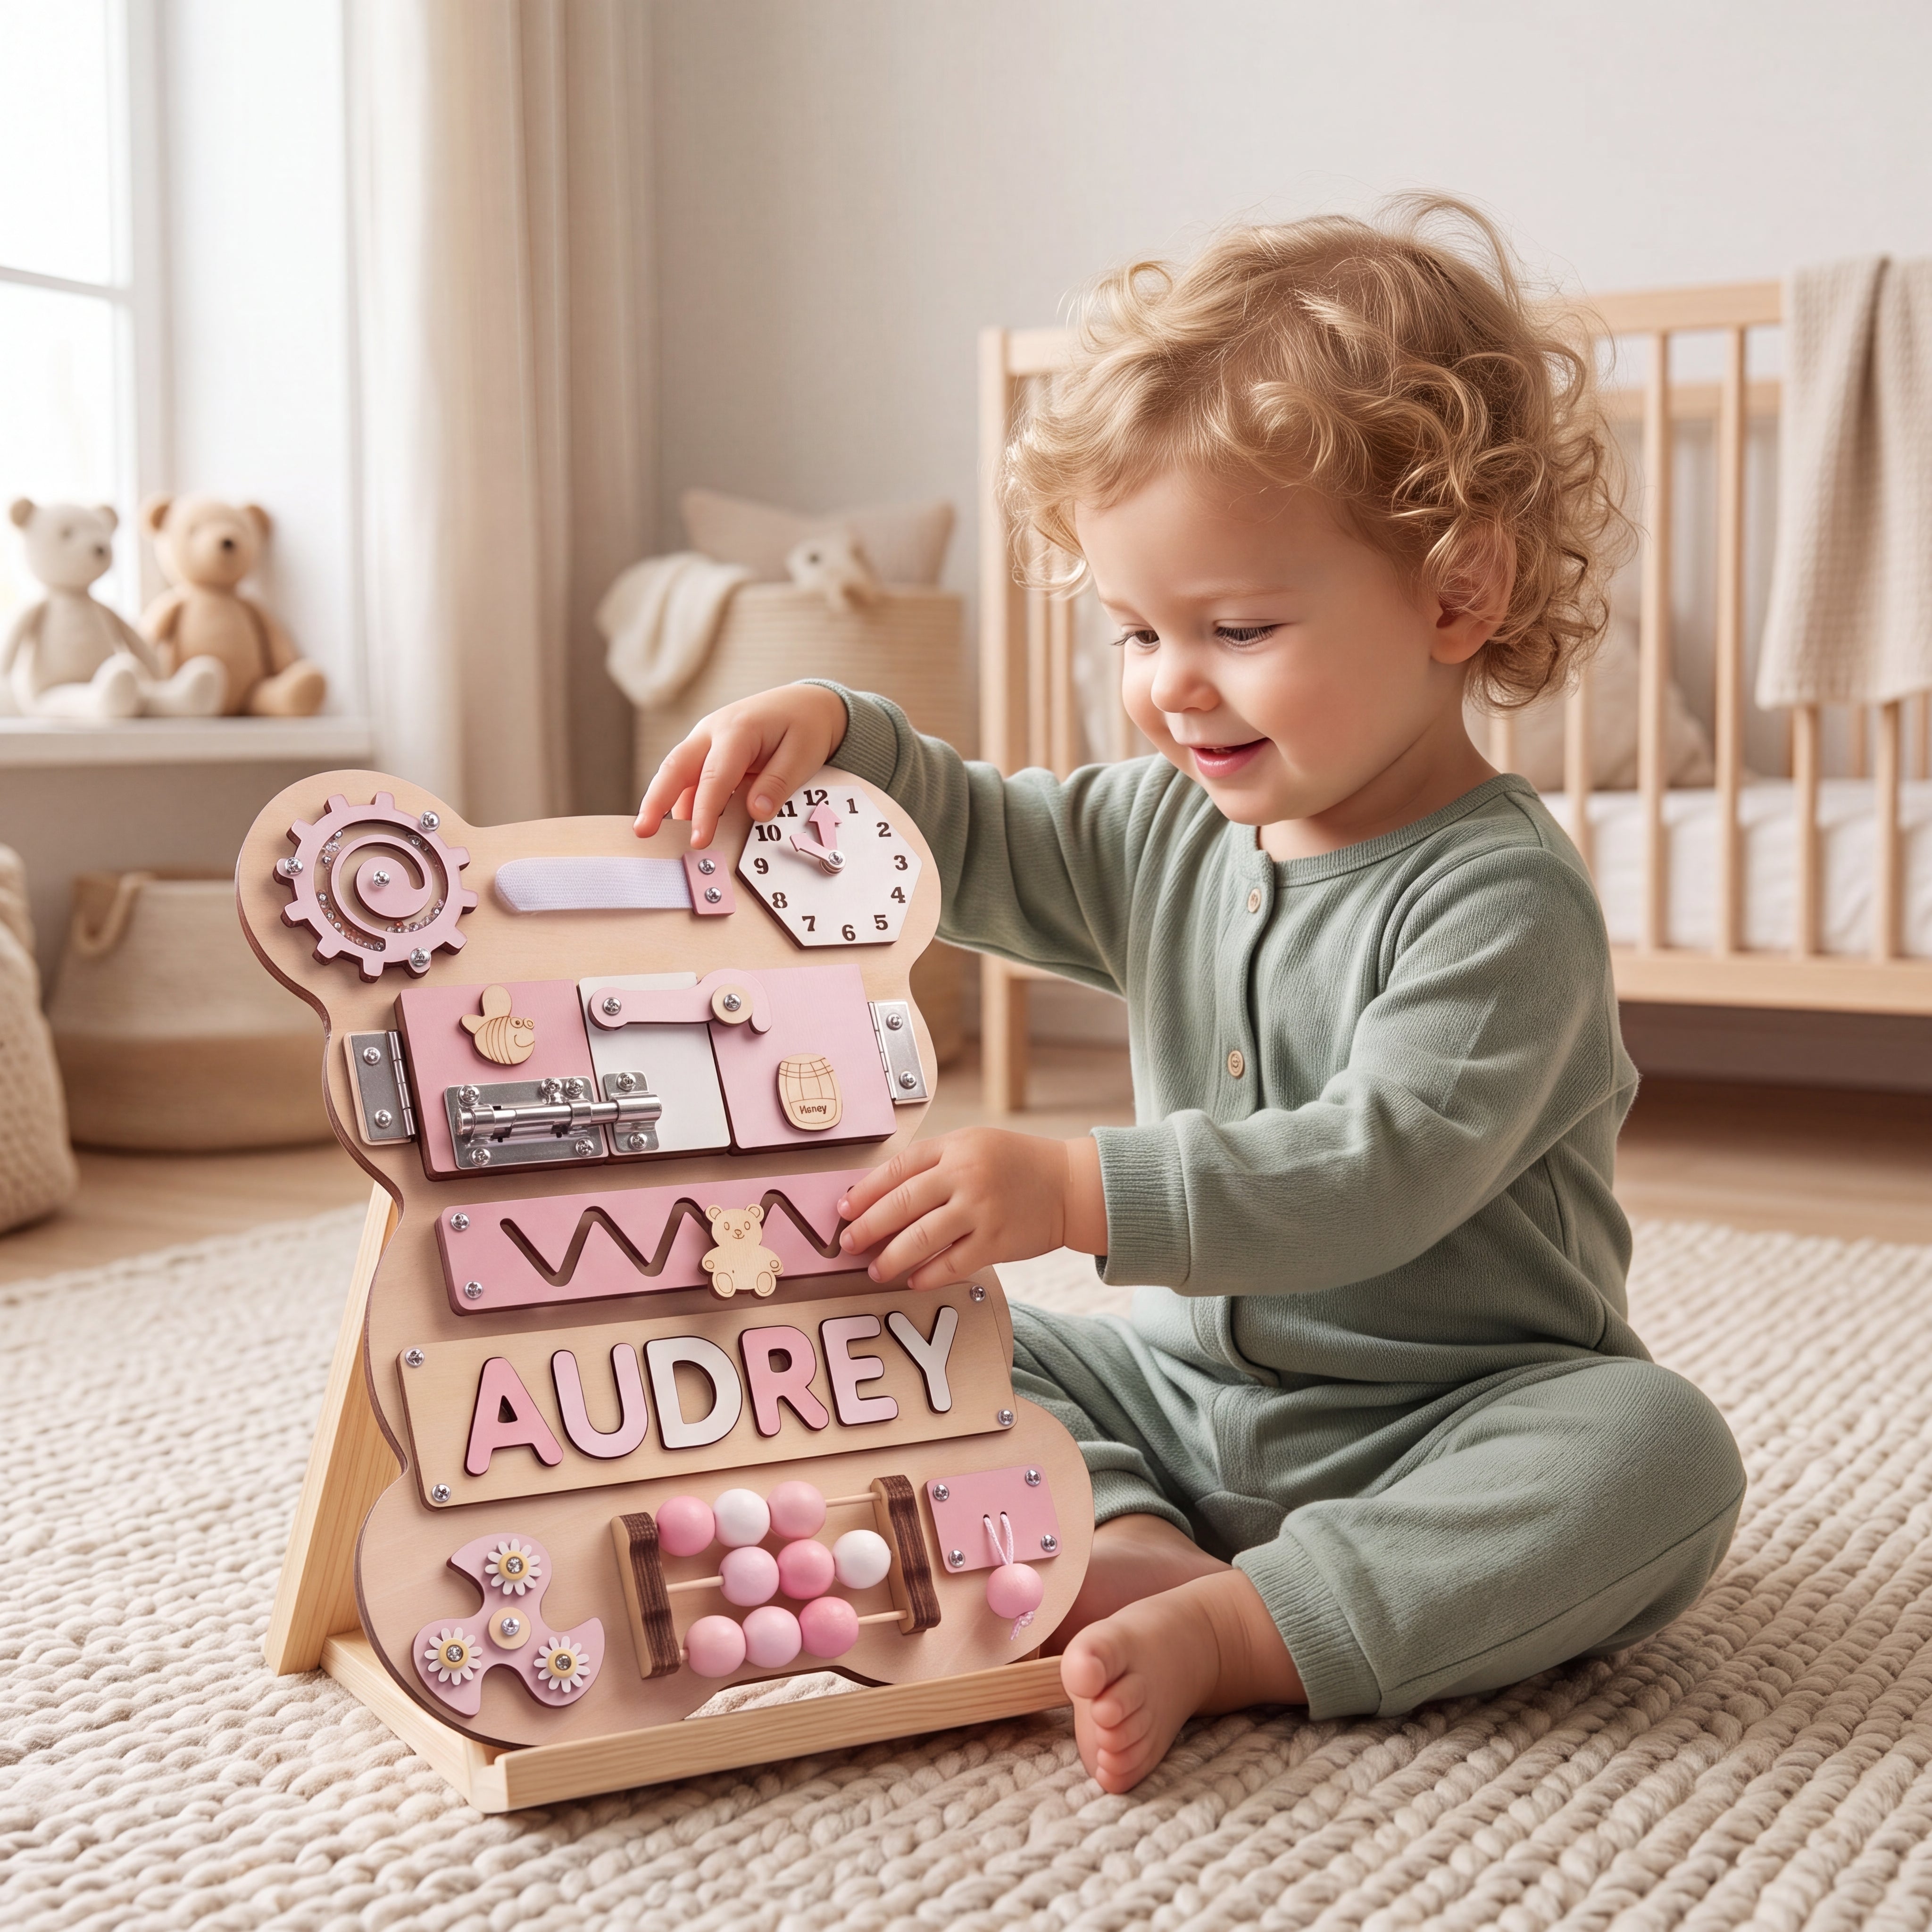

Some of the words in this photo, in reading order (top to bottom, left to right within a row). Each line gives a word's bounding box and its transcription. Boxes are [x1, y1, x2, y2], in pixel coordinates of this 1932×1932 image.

[803, 790, 829, 806] 12
[847, 799, 858, 813] 1
[755, 824, 781, 841] 10
[877, 822, 891, 837] 2
[754, 858, 768, 874] 9
[894, 855, 908, 870] 3
[772, 892, 788, 908] 8
[891, 887, 905, 903] 4
[802, 916, 815, 931] 7
[874, 915, 888, 930] 5
[842, 924, 855, 941] 6
[464, 1305, 958, 1476] AUDREY
